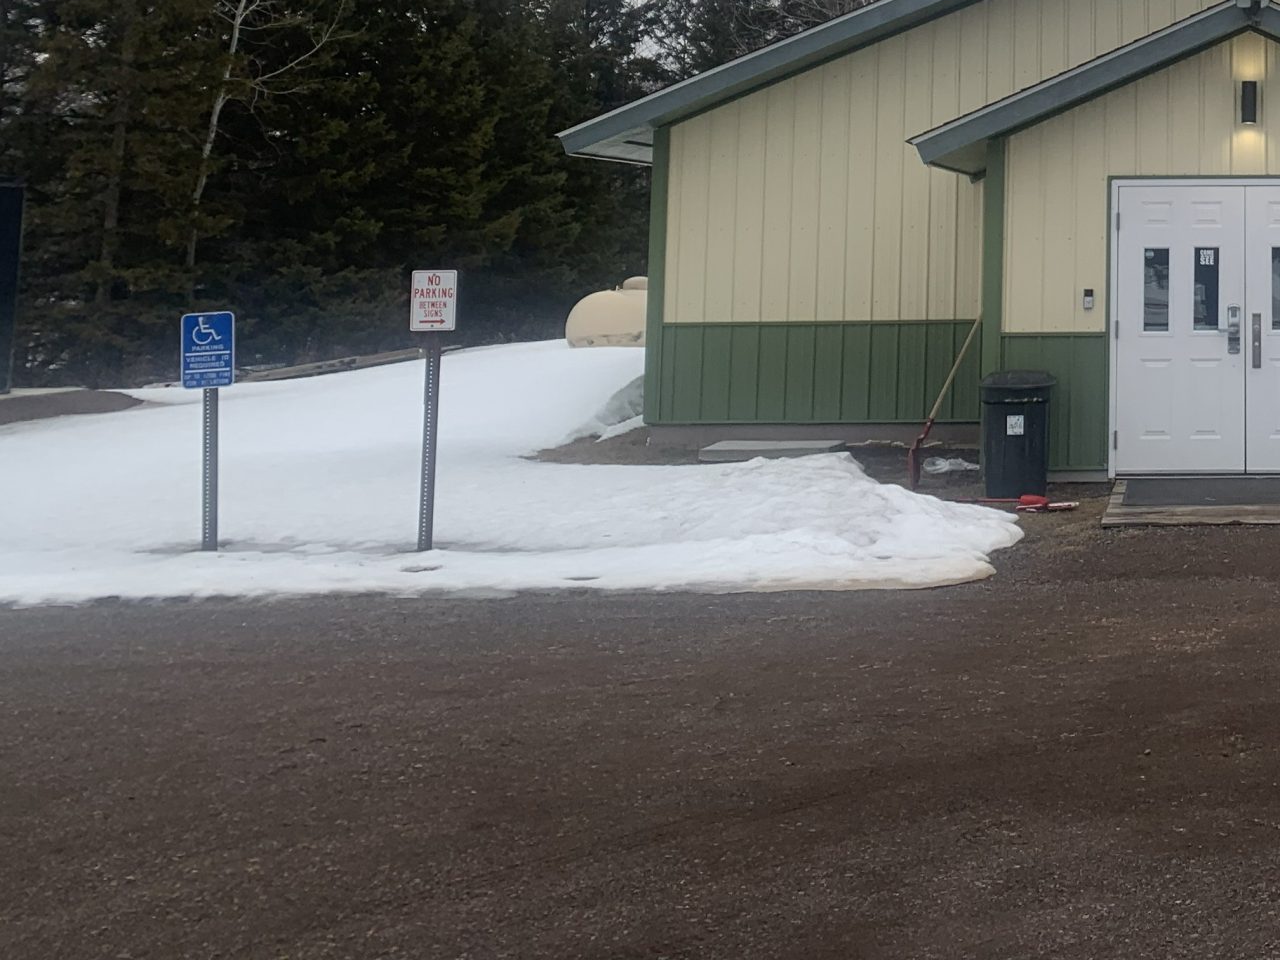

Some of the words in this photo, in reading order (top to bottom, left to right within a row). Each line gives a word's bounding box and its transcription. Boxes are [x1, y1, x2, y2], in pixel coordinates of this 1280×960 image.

[1200, 257, 1214, 265] SEE
[427, 275, 441, 286] NO
[414, 287, 453, 299] PARKING
[418, 301, 448, 310] BETWEEN
[423, 309, 443, 318] SIGNS
[185, 355, 216, 363] VEHICLE
